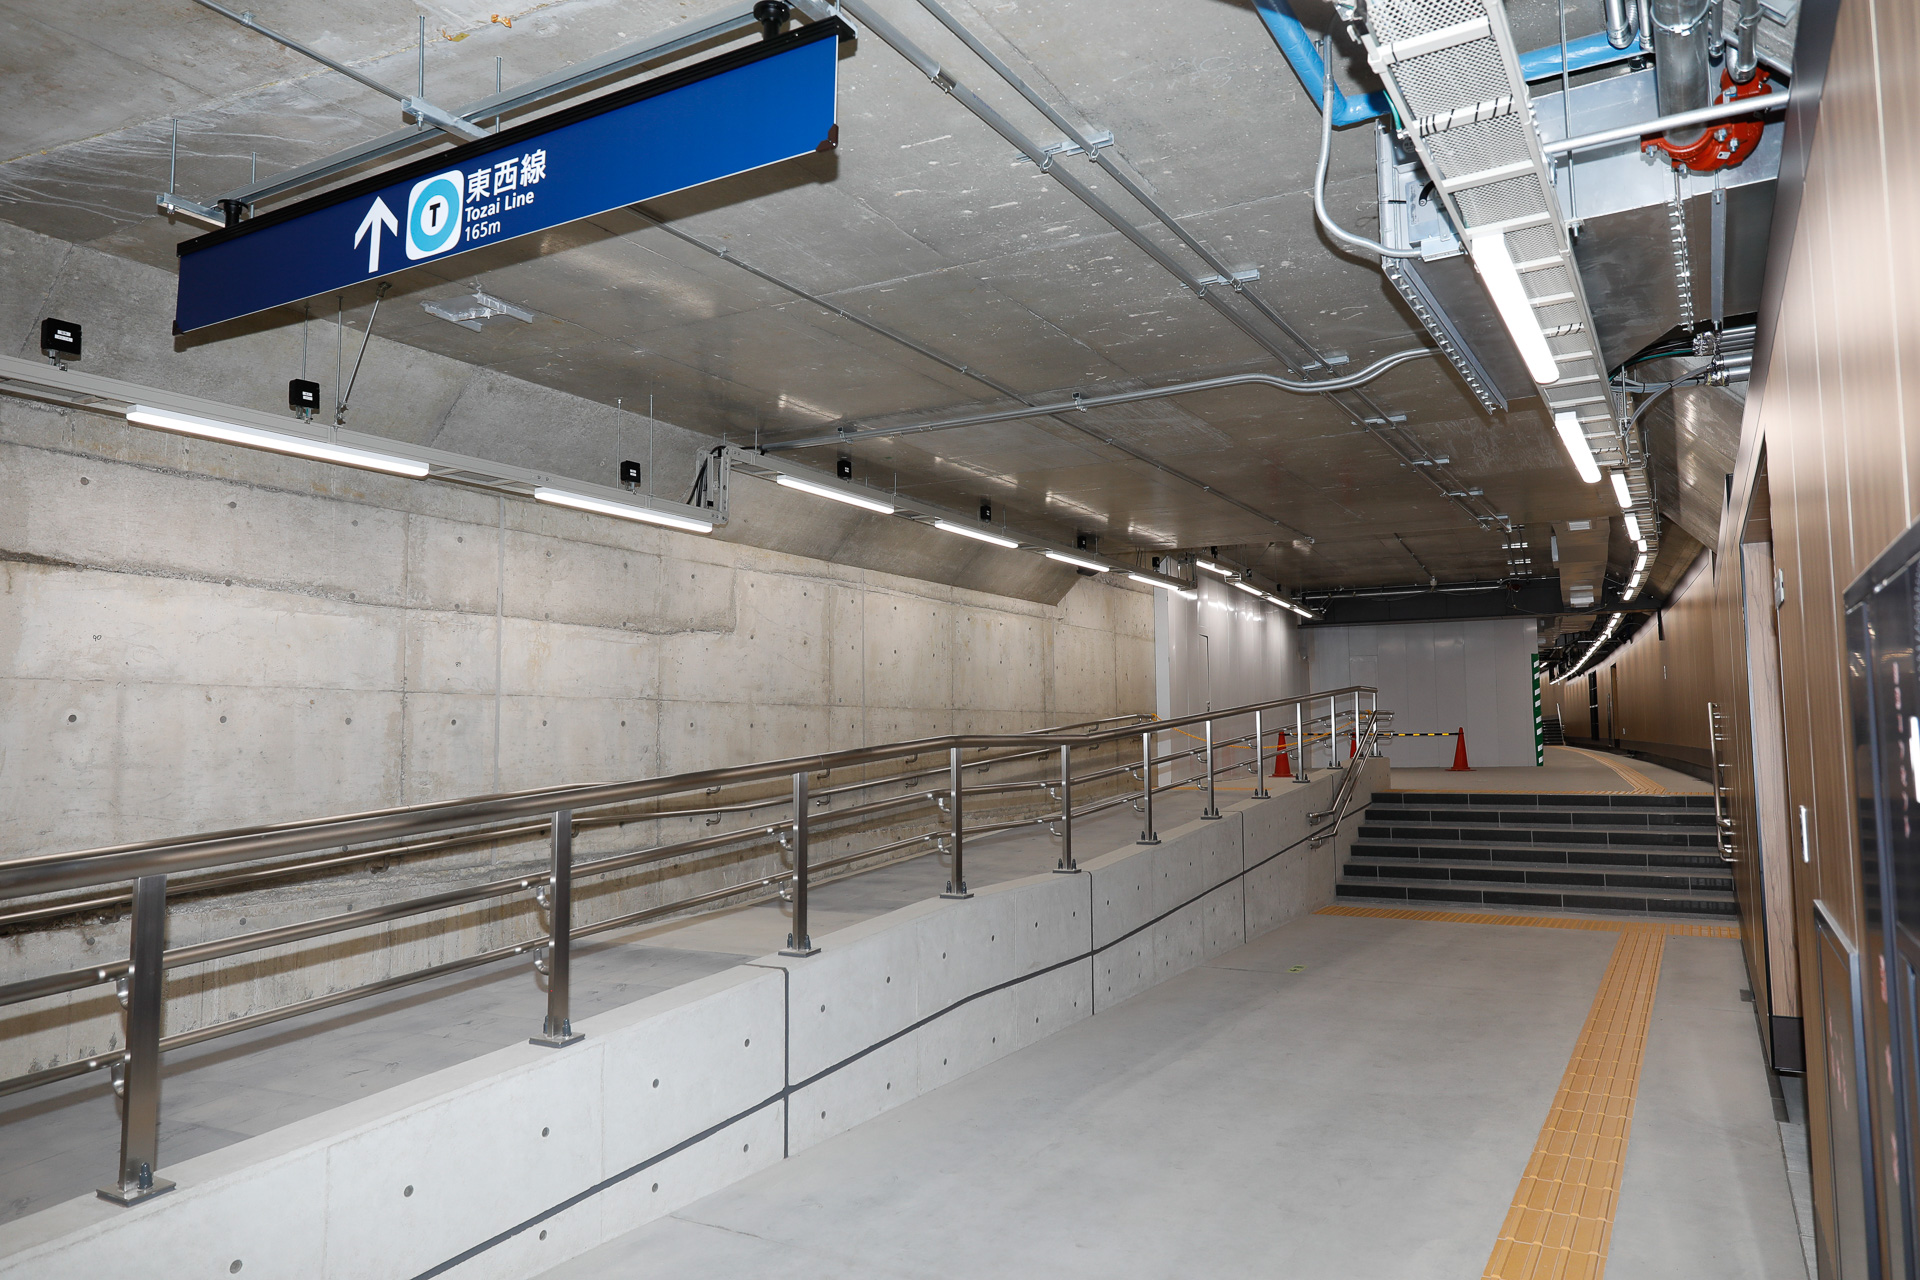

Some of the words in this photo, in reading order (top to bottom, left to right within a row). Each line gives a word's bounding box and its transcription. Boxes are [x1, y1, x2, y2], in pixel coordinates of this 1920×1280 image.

[466, 149, 546, 204] 東西線
[430, 203, 441, 227] T
[465, 197, 500, 222] Tozai
[505, 191, 535, 210] Line
[465, 220, 501, 242] 165m
